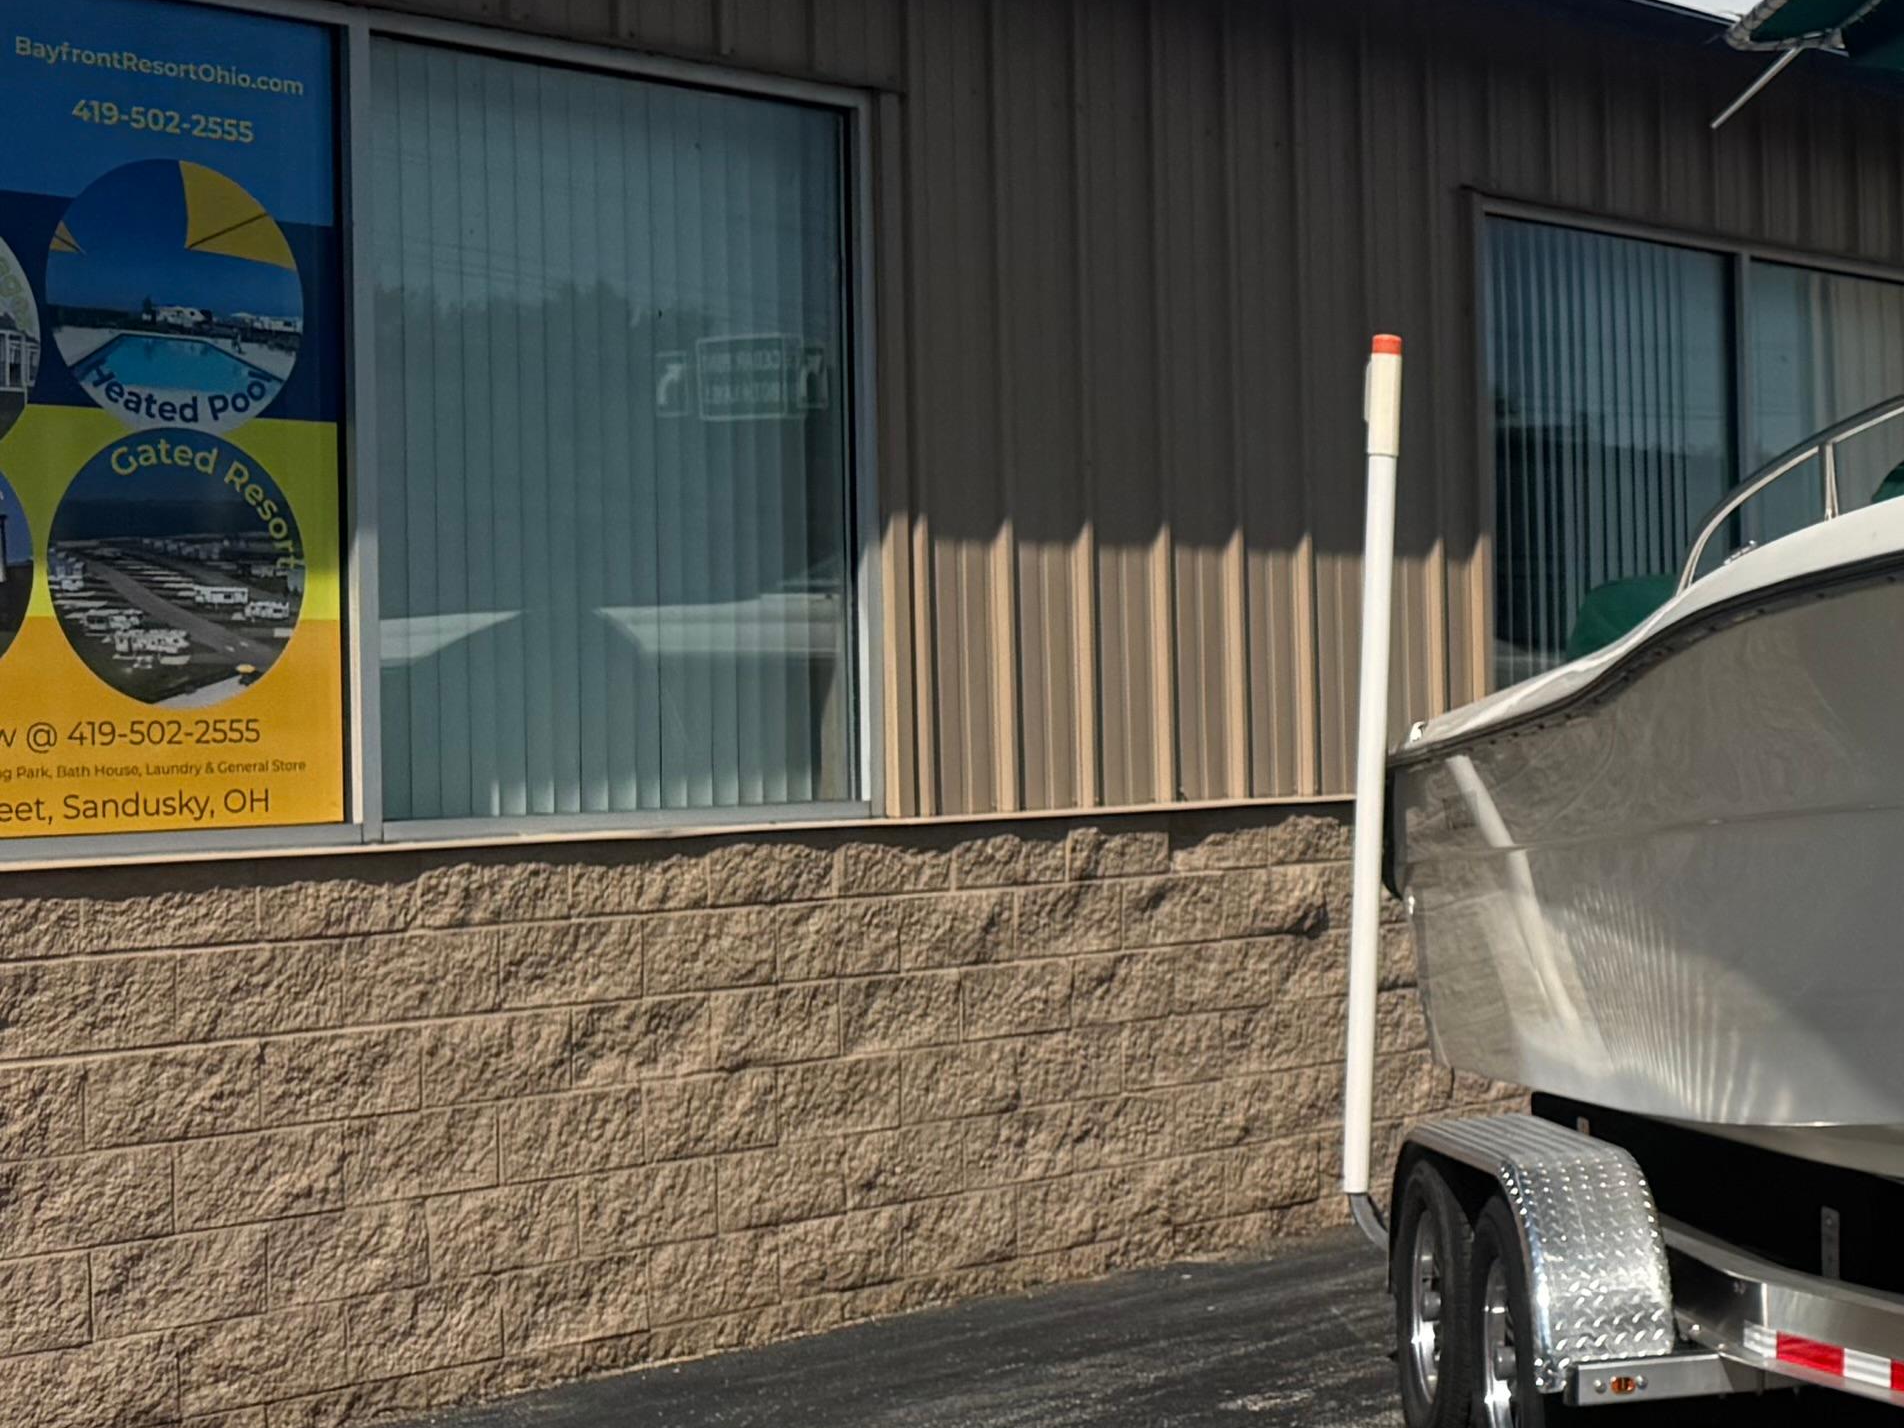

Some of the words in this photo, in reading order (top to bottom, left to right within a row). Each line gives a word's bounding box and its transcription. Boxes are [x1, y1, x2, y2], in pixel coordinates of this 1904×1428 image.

[15, 36, 304, 95] BayfrontResortOhio.com
[72, 99, 254, 143] 419-502-2555
[90, 365, 199, 423] Heated
[208, 370, 273, 420] Pool
[110, 438, 218, 475] Gated
[224, 461, 305, 570] Resort
[26, 723, 57, 753] @
[67, 719, 260, 747] 419-502-2555
[146, 762, 200, 777] Laundry
[0, 798, 53, 825] eet,
[63, 789, 214, 821] Sandusky,
[224, 788, 269, 813] OH
